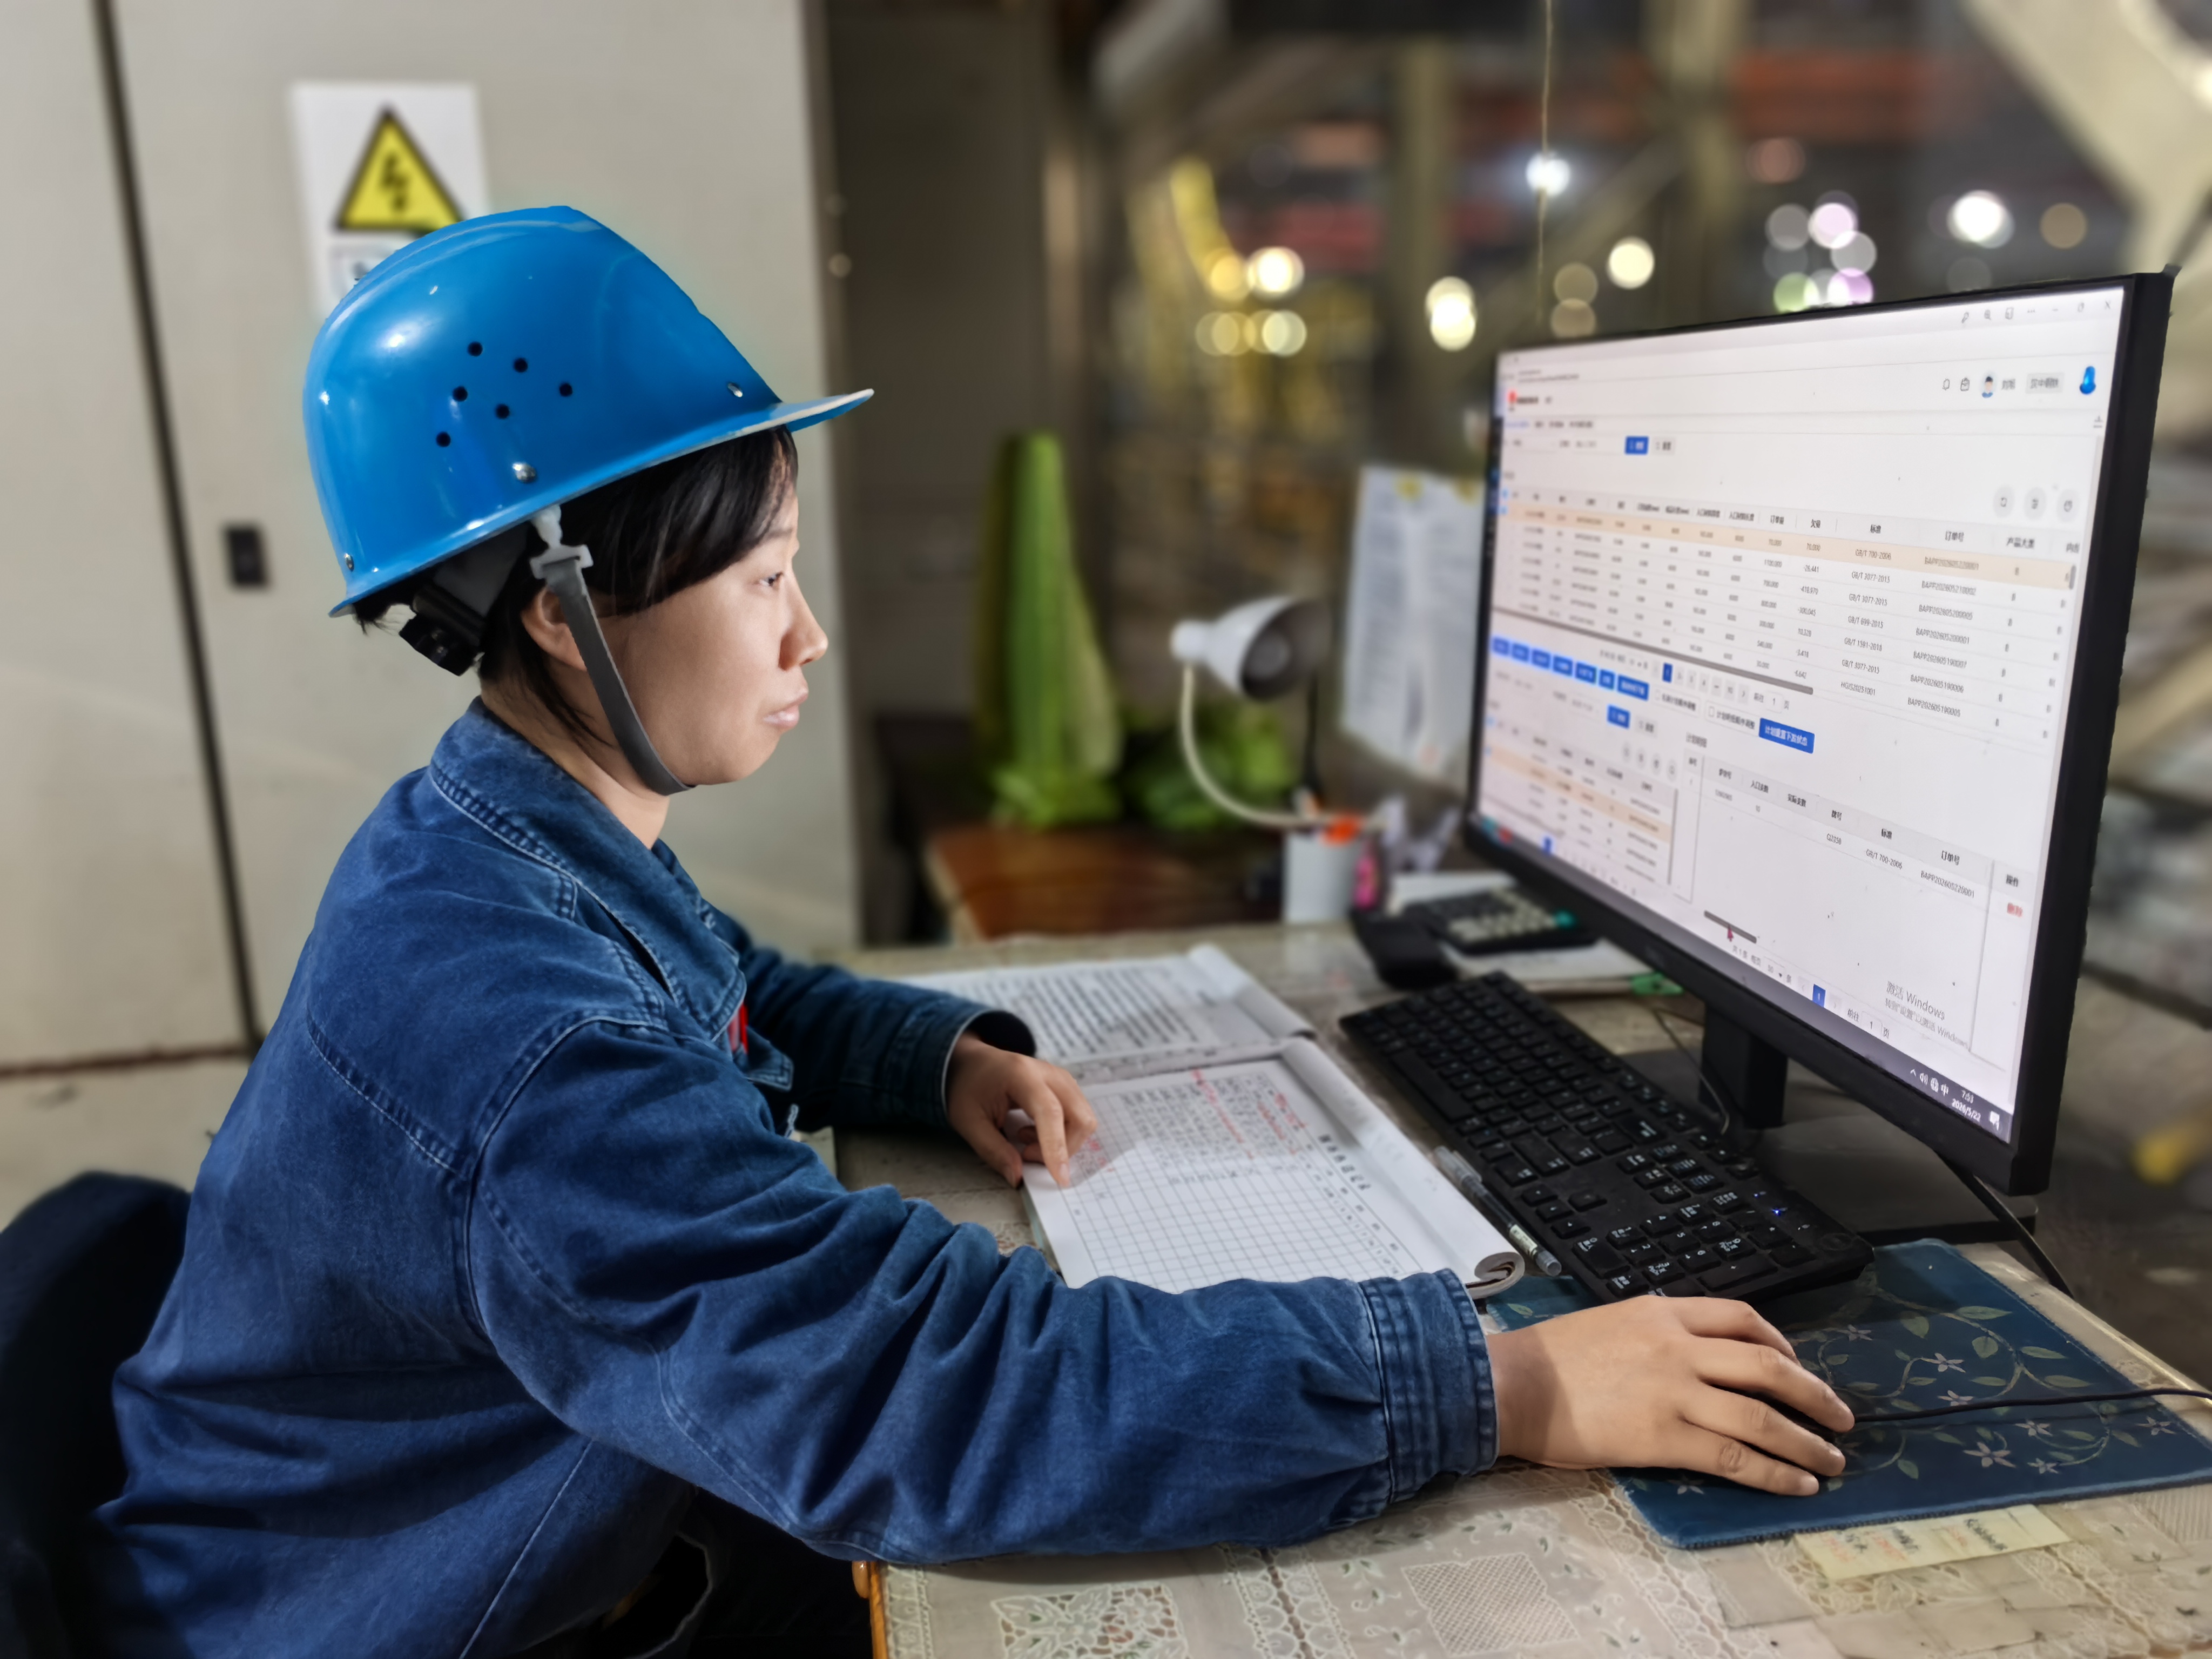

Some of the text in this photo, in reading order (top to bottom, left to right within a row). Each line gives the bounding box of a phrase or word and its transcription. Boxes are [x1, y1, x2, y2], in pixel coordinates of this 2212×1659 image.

[1811, 519, 1820, 528] 欠量
[1870, 524, 1881, 534] 标准
[1945, 531, 1964, 542] 订单号
[2007, 537, 2035, 549] 产品大类
[1849, 592, 1860, 603] GB/T
[1844, 637, 1856, 646] GB/T
[1754, 692, 1789, 710] 前往 1 页
[1788, 793, 1806, 807] 实际支数
[1831, 810, 1842, 821] 牌号
[1881, 828, 1892, 840] 标准
[1941, 850, 1959, 866] 订单号
[2006, 874, 2019, 888] 操作
[1886, 980, 1945, 1021] 激活 Windows
[1847, 1008, 1859, 1022] 前往
[1883, 1027, 1889, 1039] 页
[1940, 1082, 1948, 1098] 中
[1951, 1097, 1981, 1123] 2026/5/22
